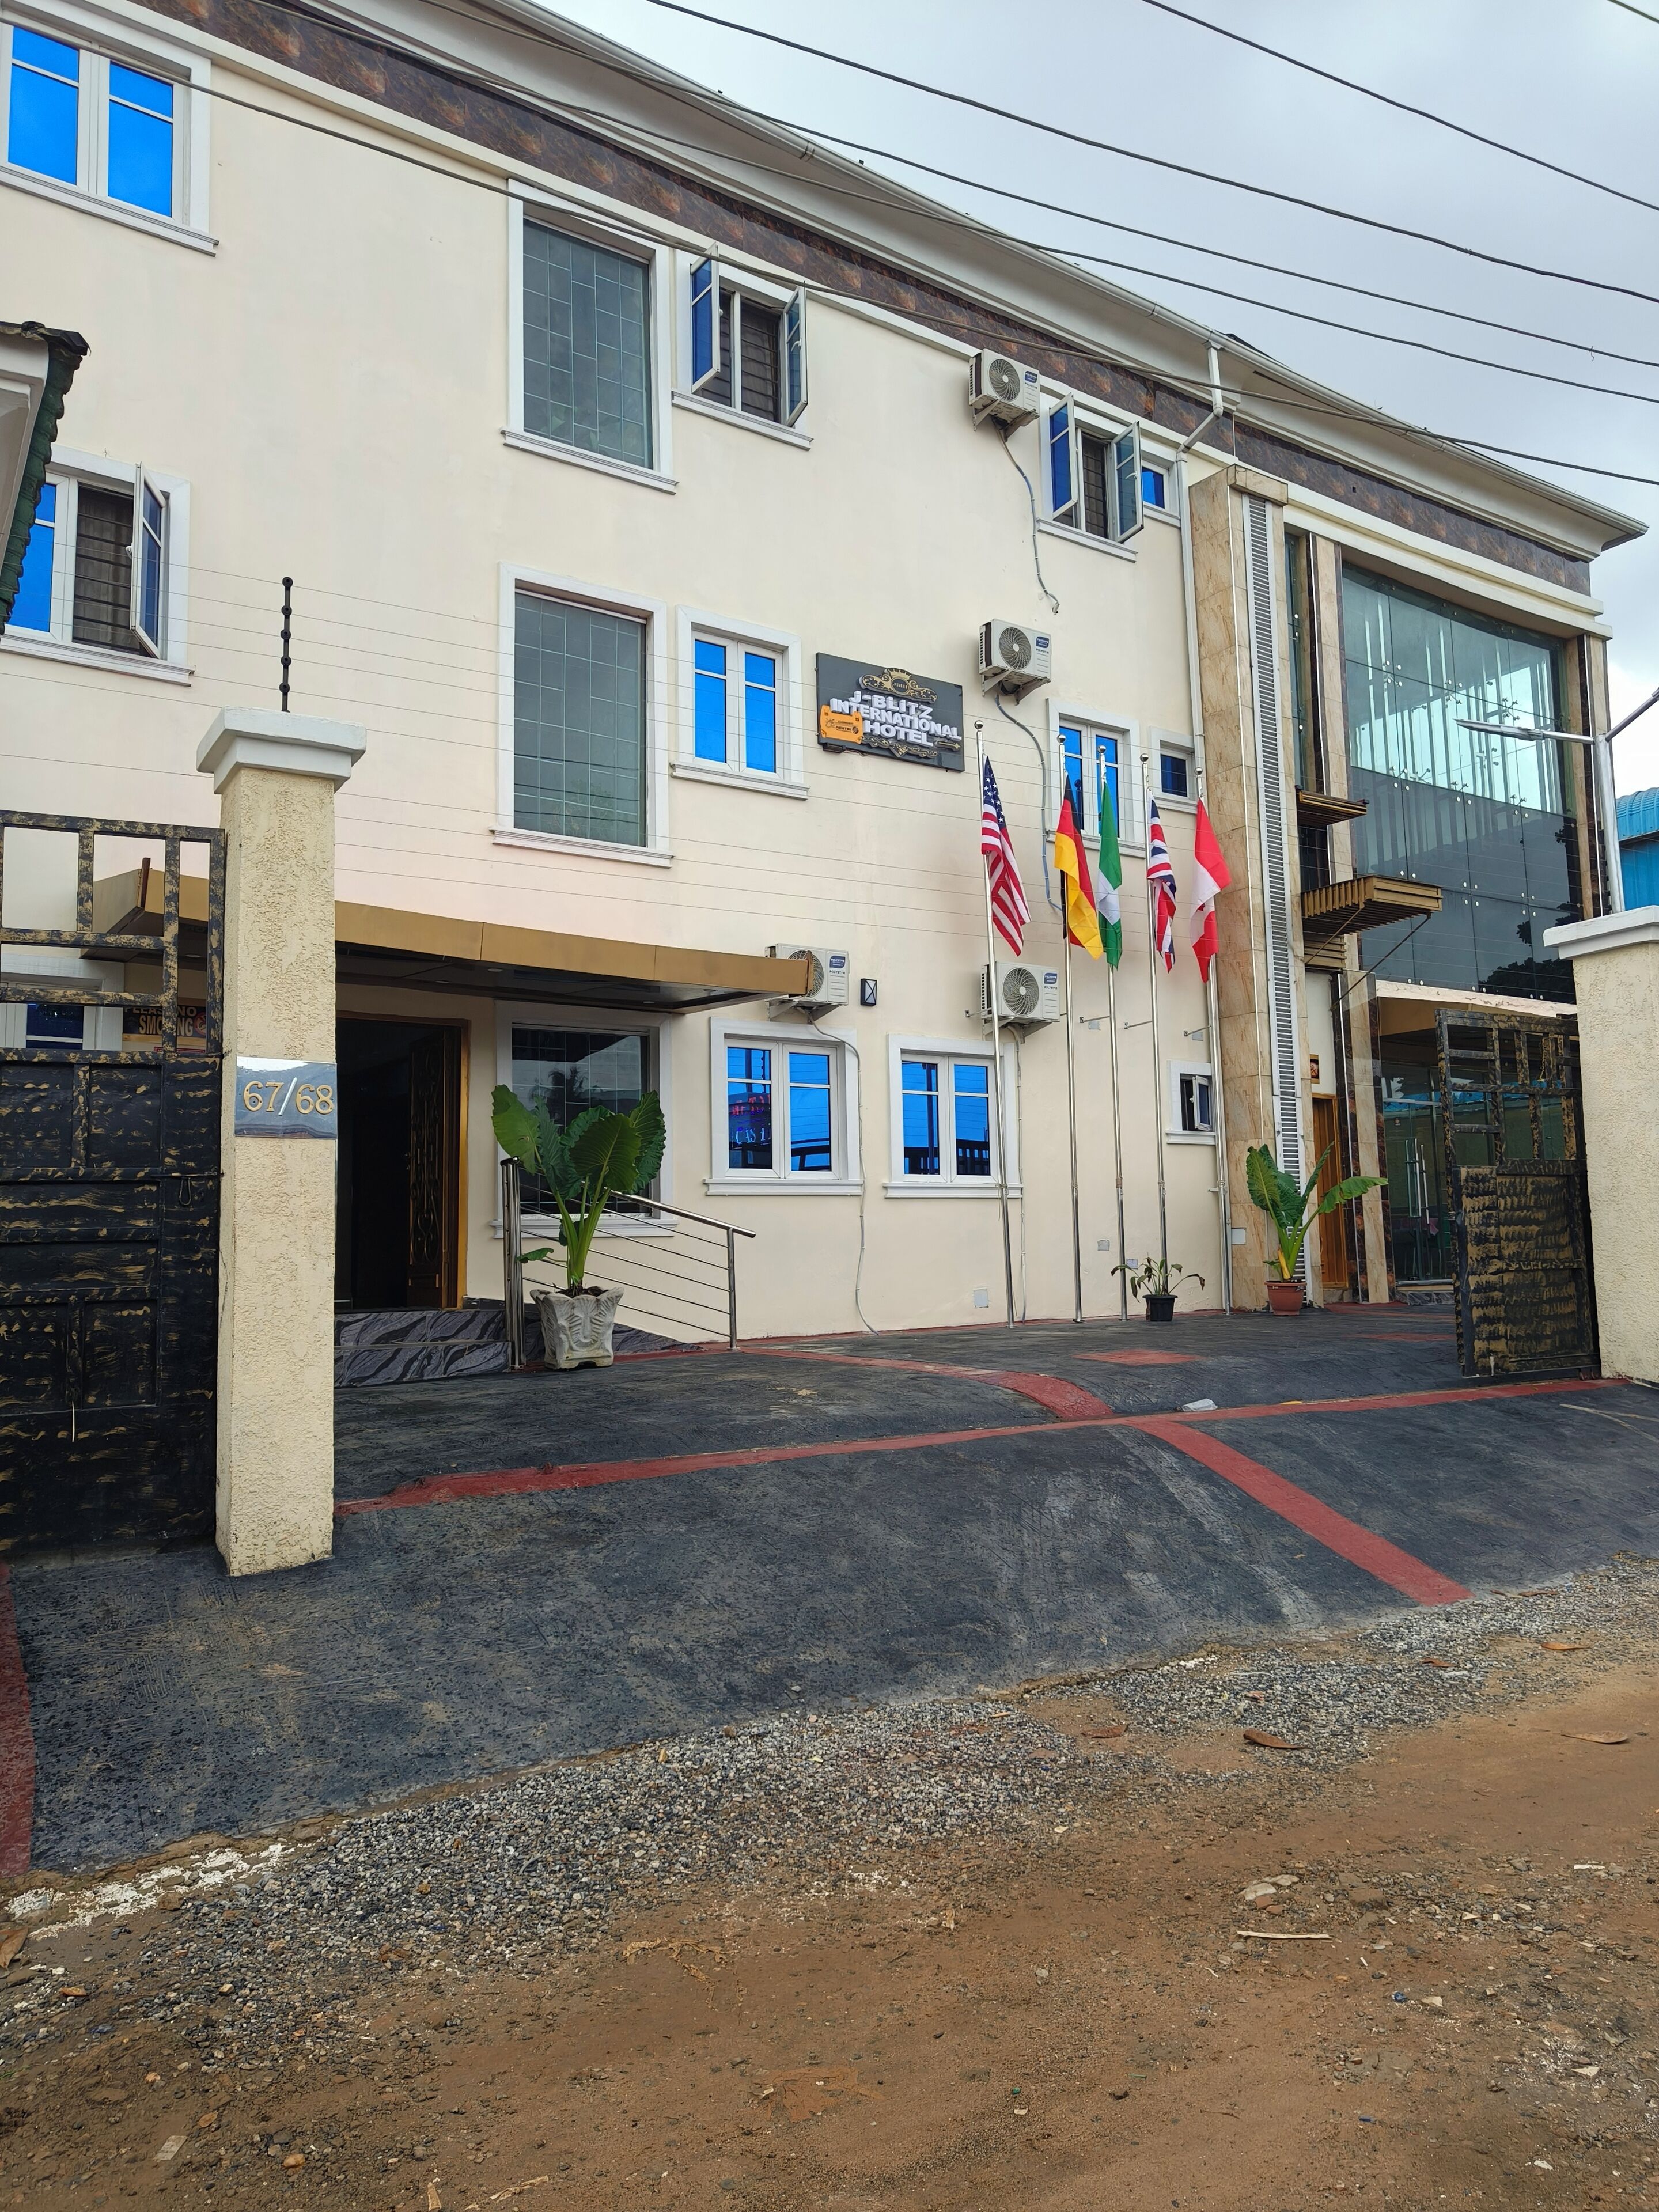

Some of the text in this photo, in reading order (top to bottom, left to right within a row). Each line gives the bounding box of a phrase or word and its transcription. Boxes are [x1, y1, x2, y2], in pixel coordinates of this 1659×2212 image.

[830, 698, 962, 741] INTERNATIONAL
[848, 691, 933, 720] J-BLITZ
[863, 719, 933, 747] HOTEL
[139, 1014, 194, 1036] SMONG
[244, 1077, 334, 1116] 67/68
